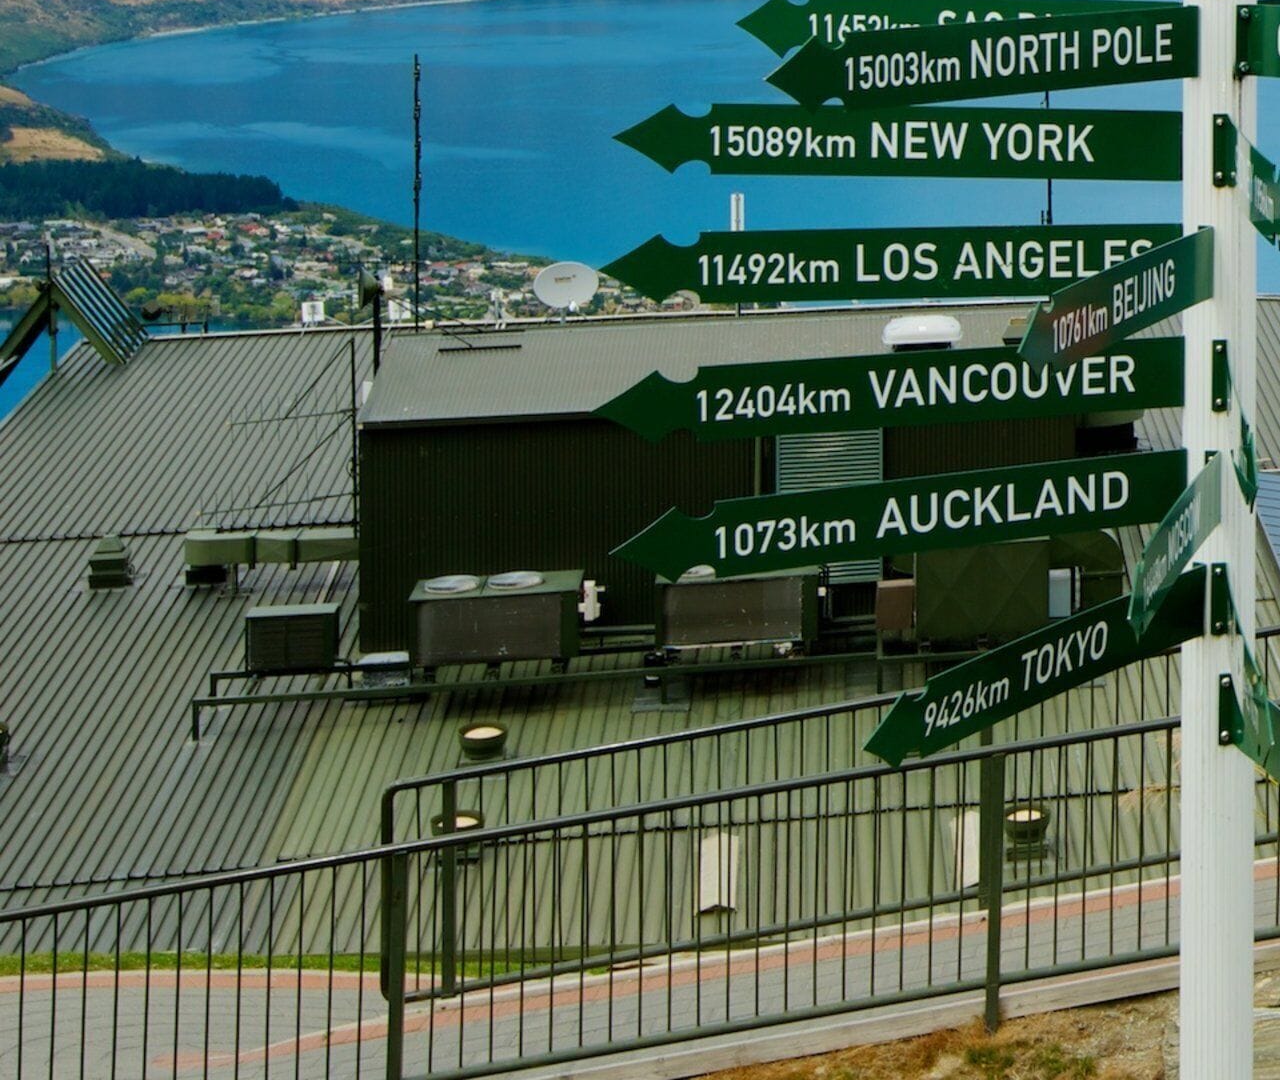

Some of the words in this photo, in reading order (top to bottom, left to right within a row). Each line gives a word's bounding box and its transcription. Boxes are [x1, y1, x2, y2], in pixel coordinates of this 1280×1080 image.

[845, 50, 961, 91] 15003km
[970, 30, 1080, 79] NORTH
[1092, 23, 1173, 68] POLE
[710, 125, 856, 158] 15089km
[871, 121, 969, 160] NEW
[982, 122, 1095, 162] YORK
[698, 252, 839, 286] 11492km
[856, 242, 939, 282] LOS
[1052, 304, 1109, 354] 10761km
[1112, 258, 1176, 326] BEIJING
[697, 383, 851, 422] 12404km
[868, 355, 1136, 409] VANCOUVER
[715, 515, 856, 559] 1073km
[876, 471, 1129, 539] AUCKLAND
[924, 677, 1010, 736] 9426km
[1021, 621, 1108, 691] TOKYO
